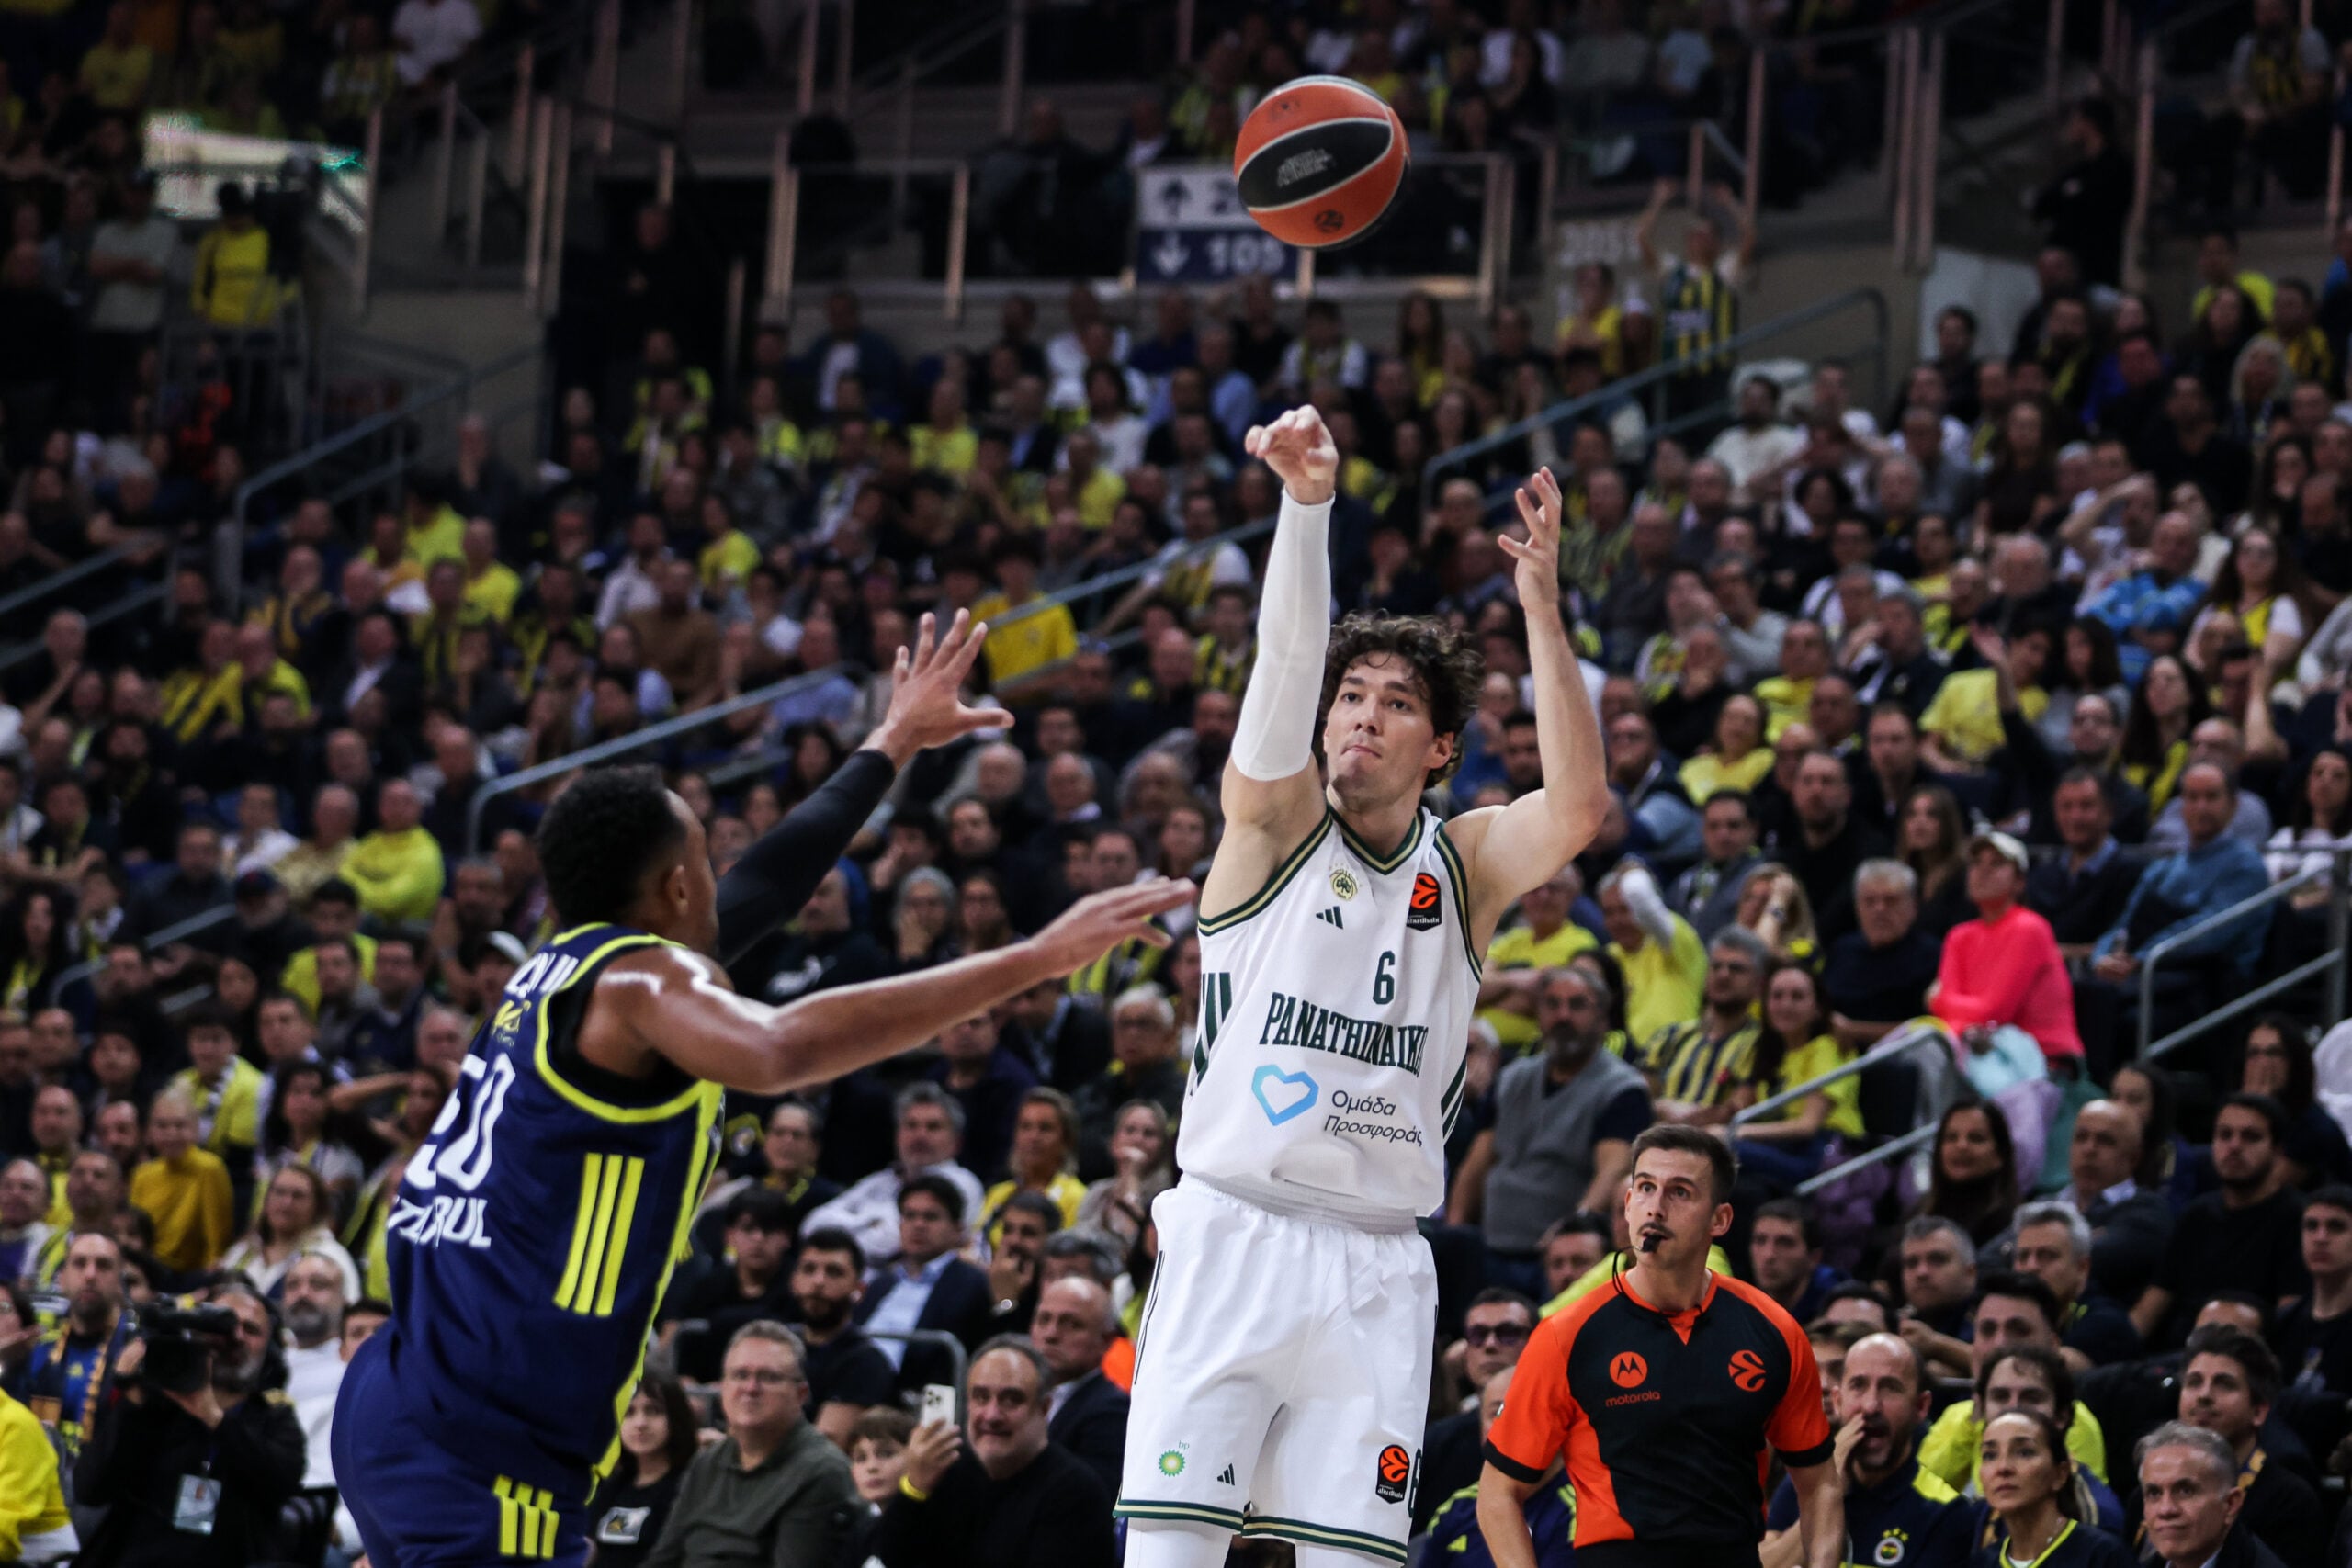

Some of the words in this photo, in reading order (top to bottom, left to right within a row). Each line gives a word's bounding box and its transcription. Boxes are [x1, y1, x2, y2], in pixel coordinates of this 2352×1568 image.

[1372, 950, 1396, 1005] 6
[1259, 991, 1430, 1078] PANATHINAIK
[1331, 1089, 1397, 1116] Ομάδα
[1324, 1114, 1423, 1147] Προσφοράς
[1605, 1390, 1661, 1407] motorola
[1178, 1439, 1190, 1450] bp
